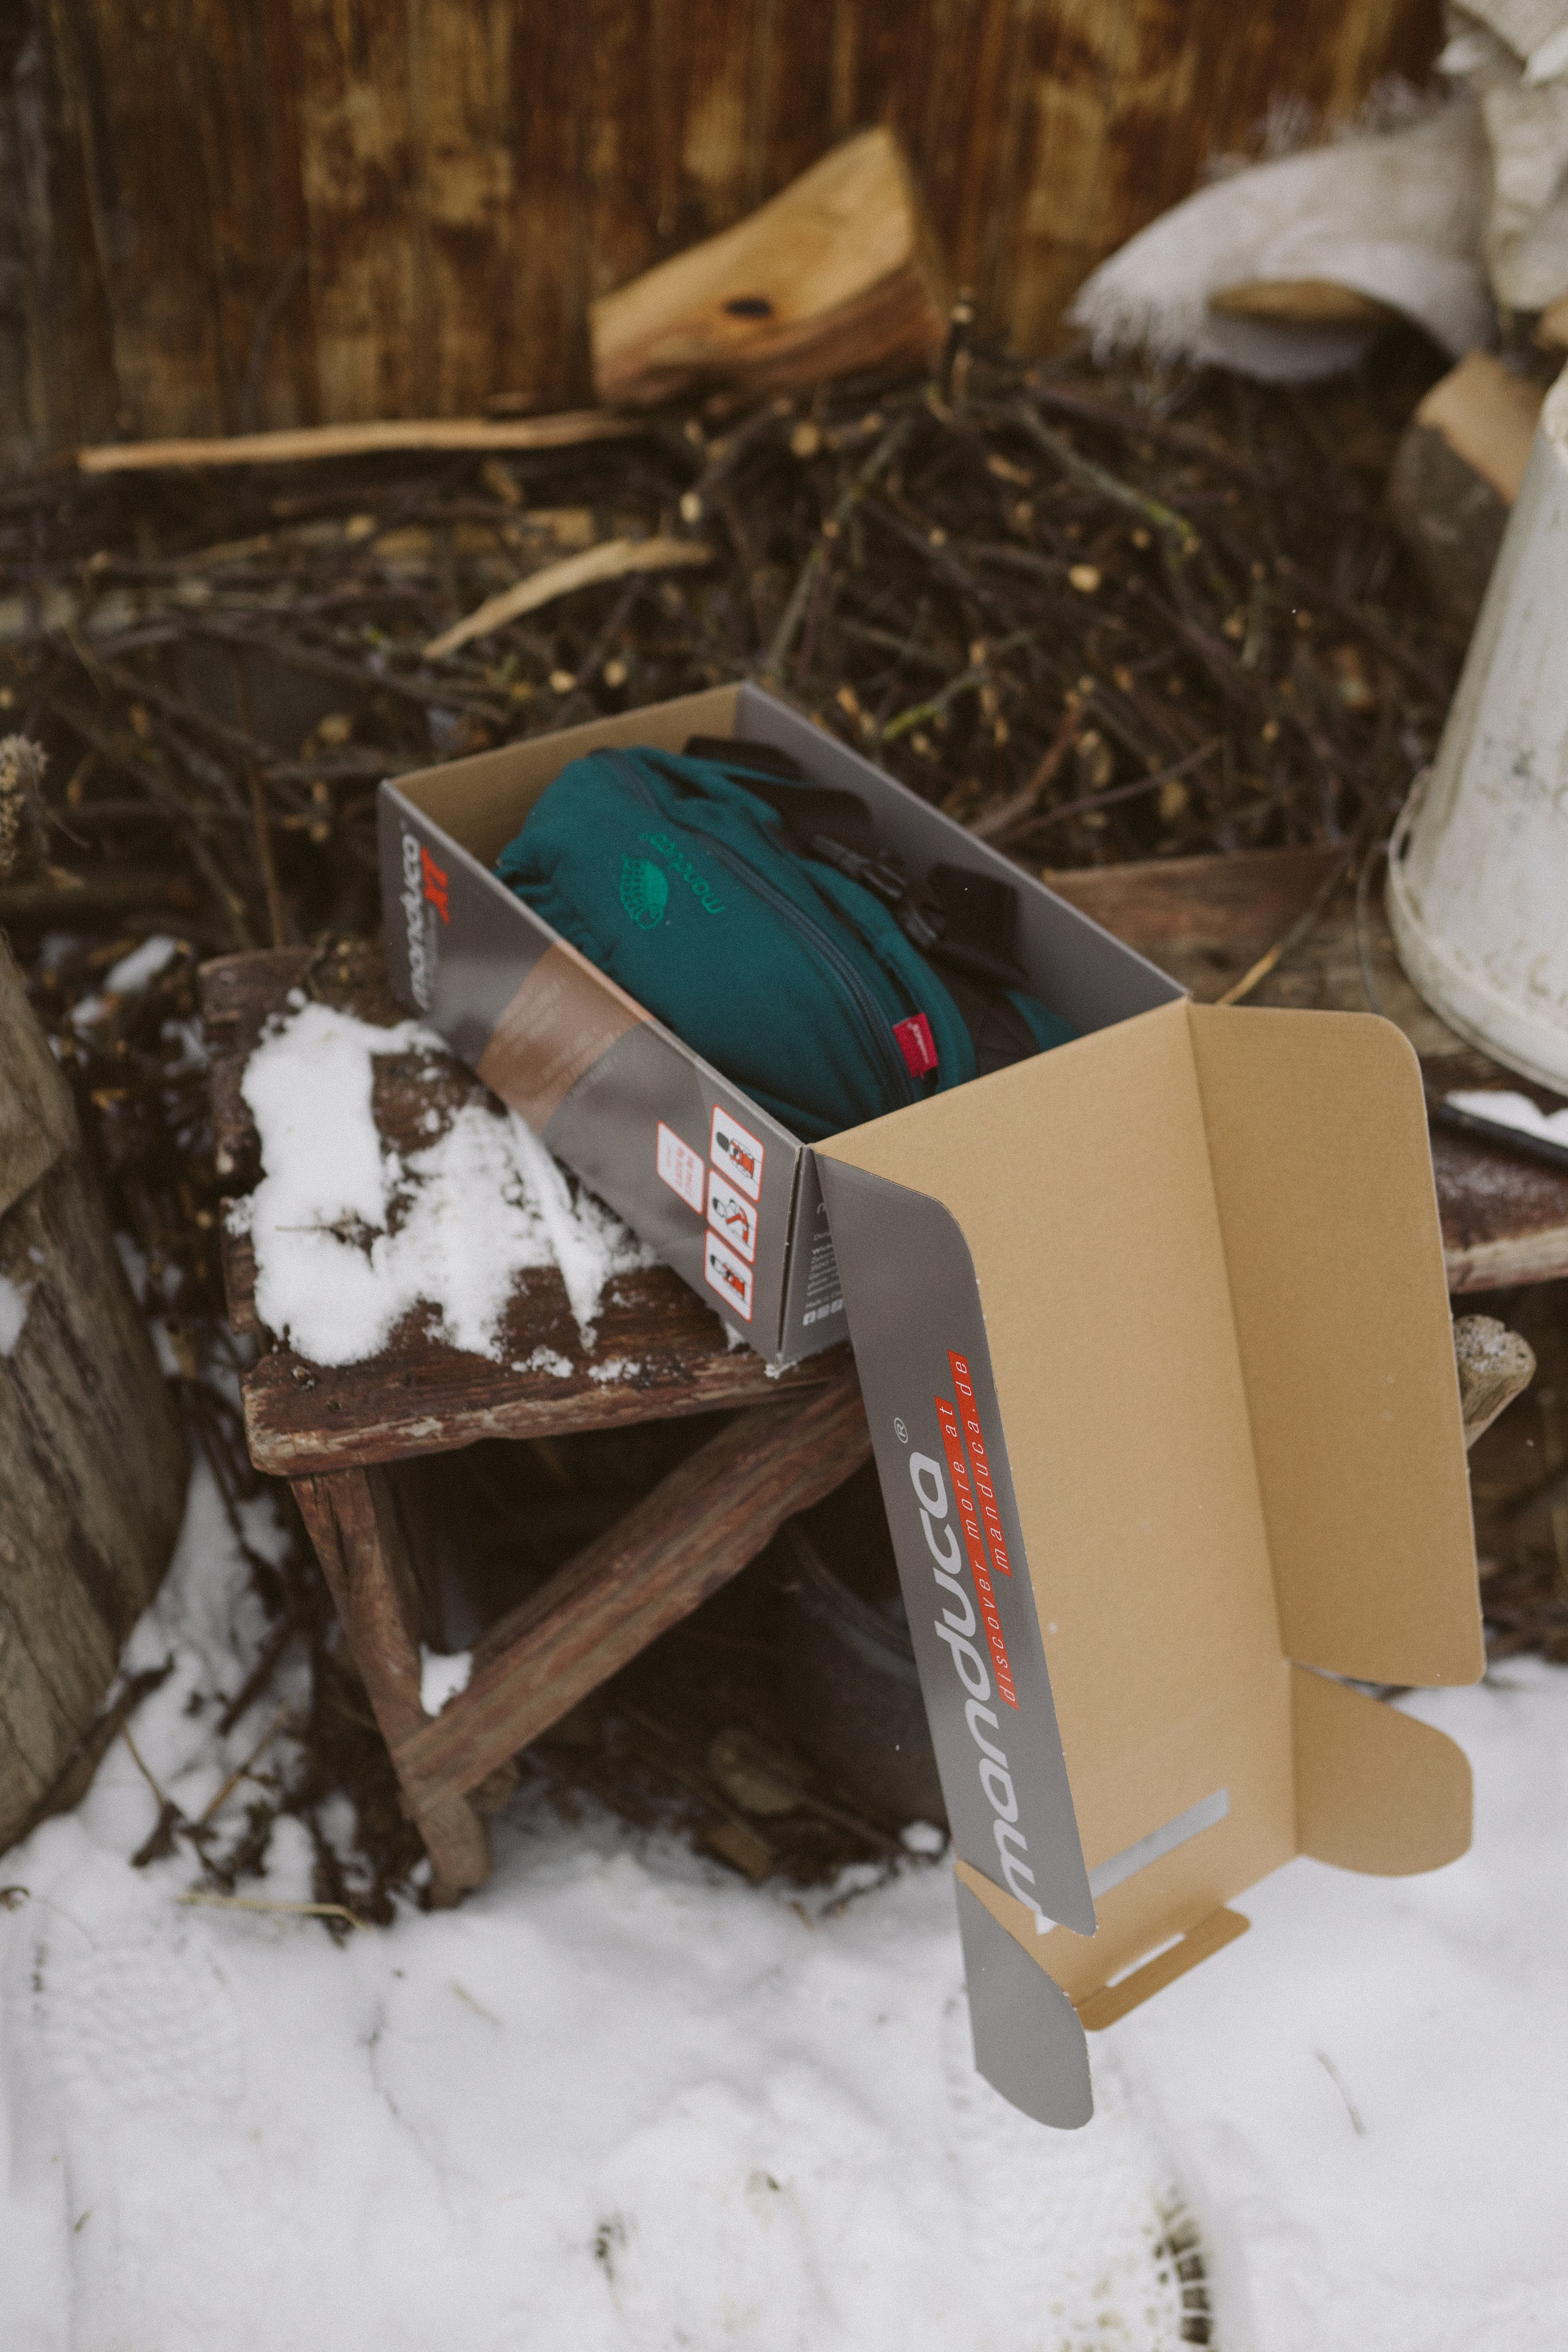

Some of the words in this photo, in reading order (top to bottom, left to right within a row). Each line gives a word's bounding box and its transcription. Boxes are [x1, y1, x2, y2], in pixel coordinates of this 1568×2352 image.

[399, 833, 429, 1009] manduca
[649, 831, 726, 914] manduca
[939, 1406, 958, 1438] at
[955, 1360, 1009, 1570] manduca.de
[953, 1461, 980, 1540] more
[909, 1451, 1042, 1916] manduca
[974, 1560, 1016, 1702] discover
